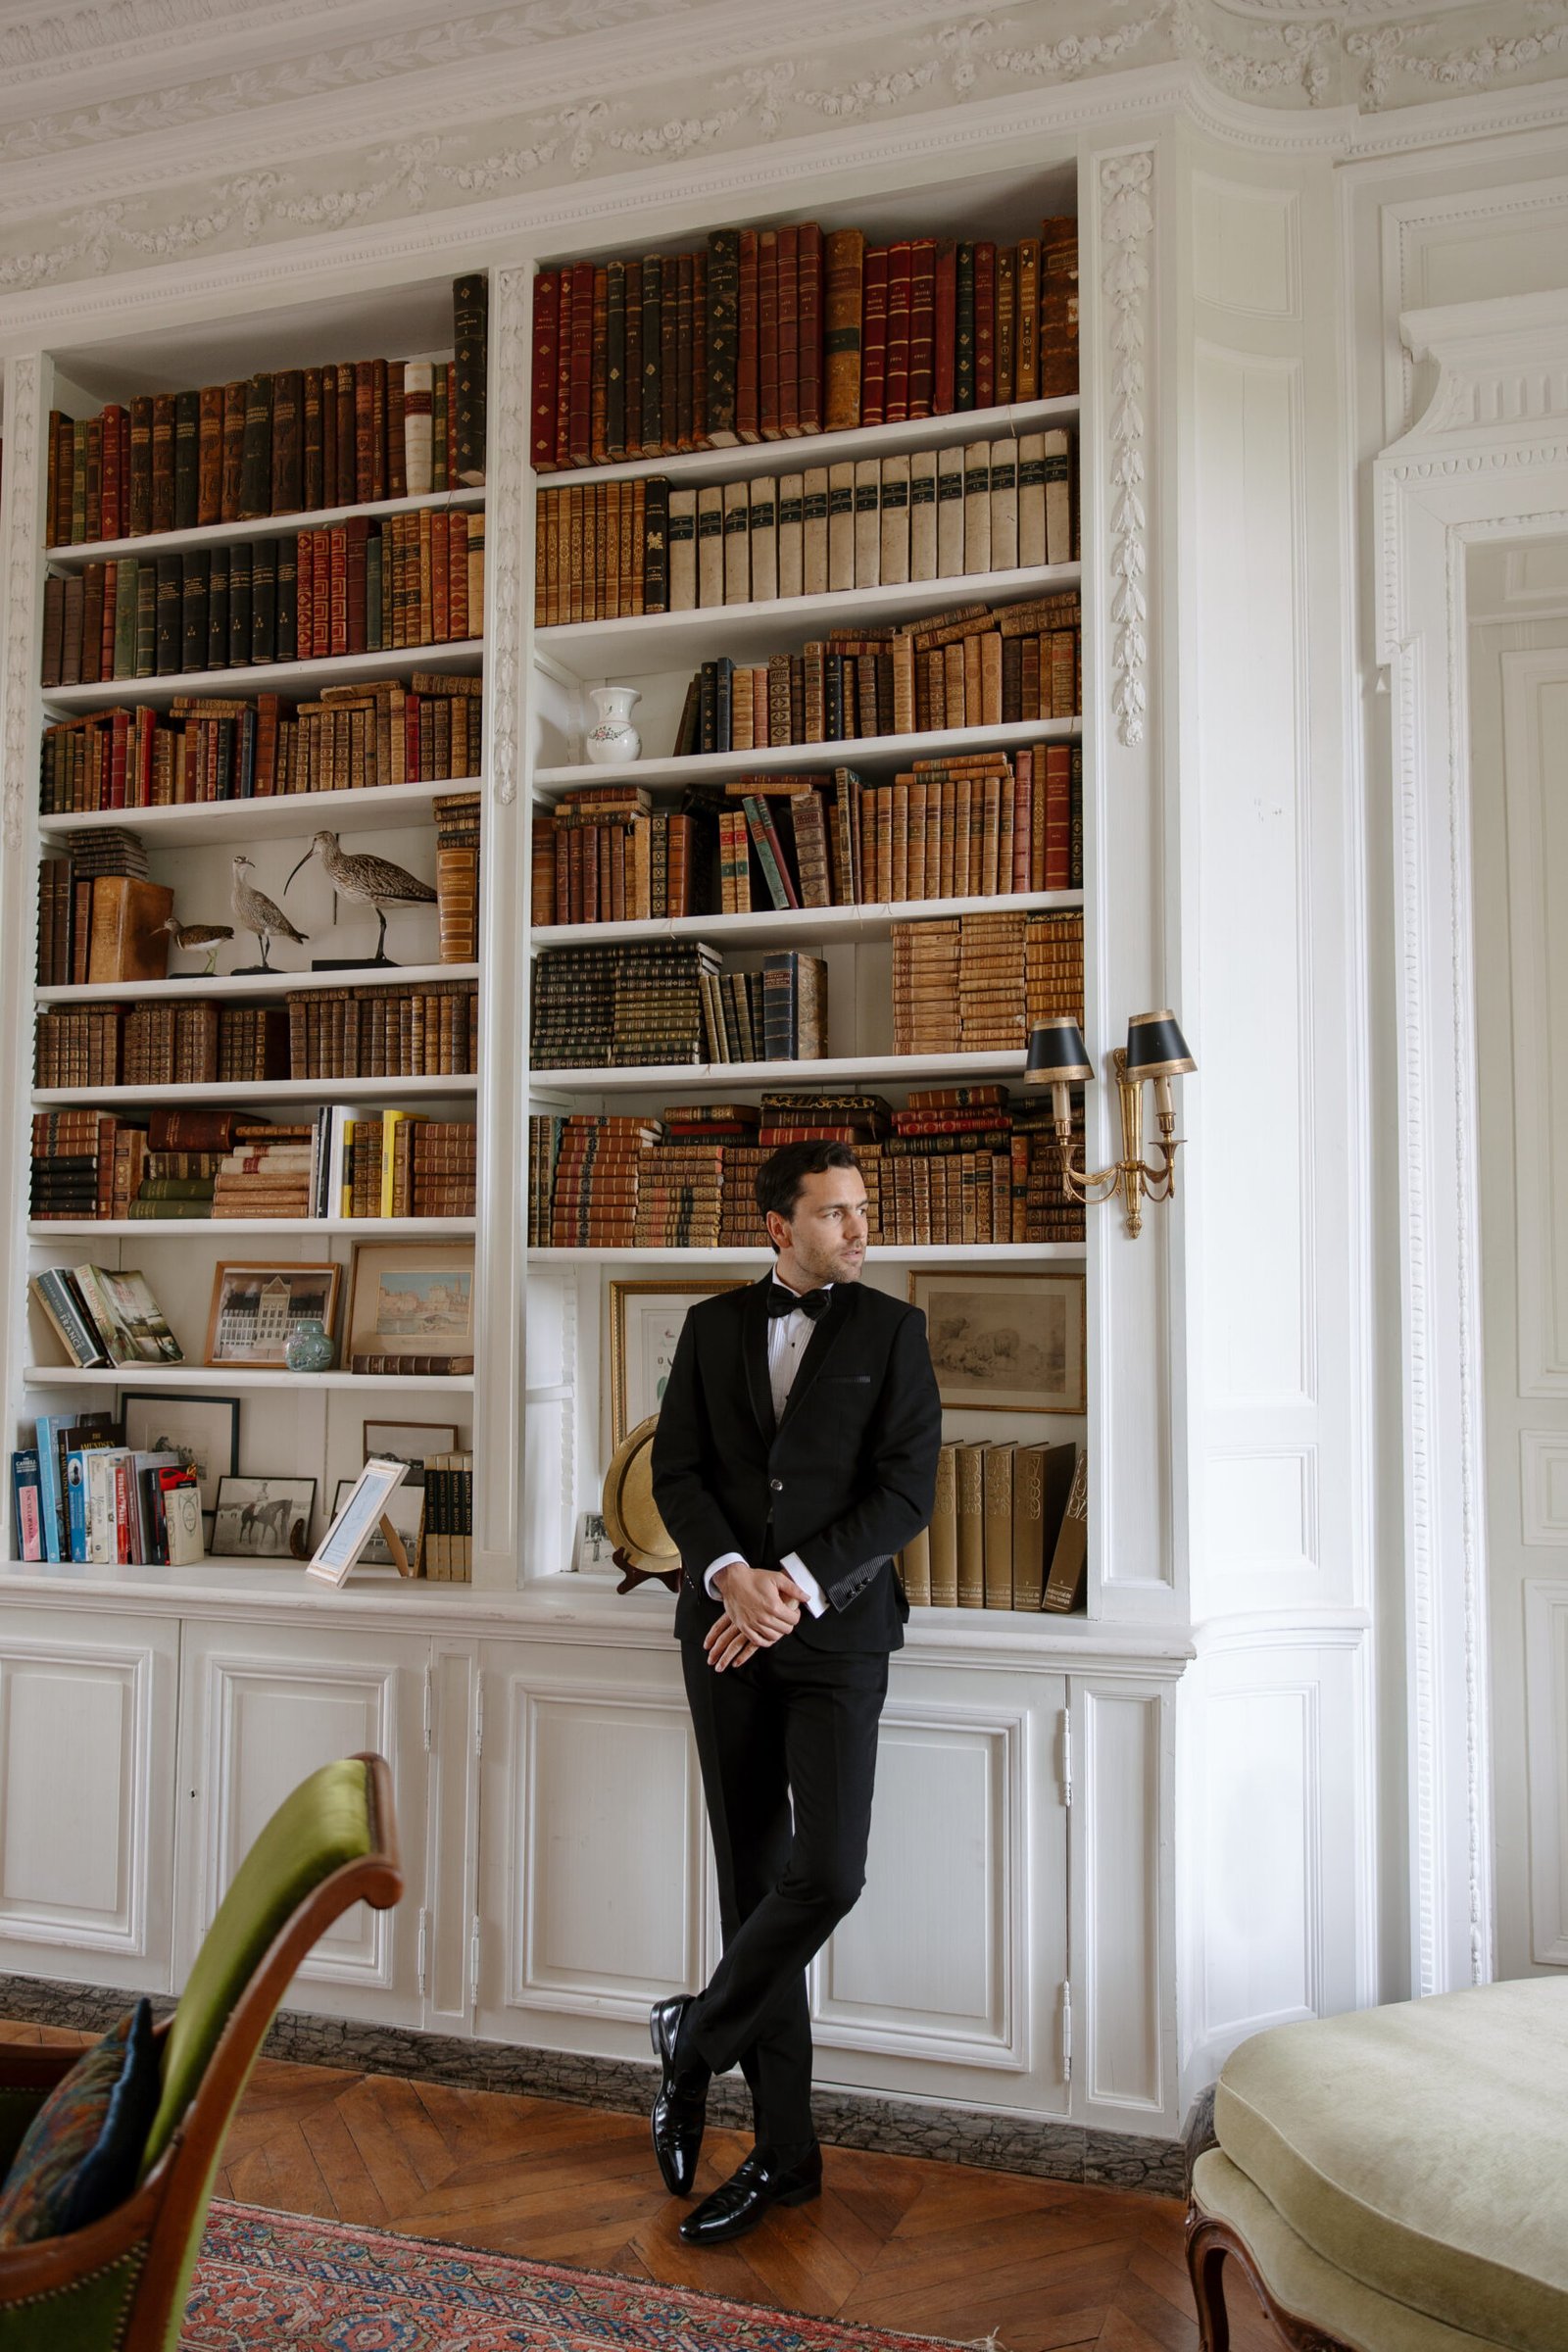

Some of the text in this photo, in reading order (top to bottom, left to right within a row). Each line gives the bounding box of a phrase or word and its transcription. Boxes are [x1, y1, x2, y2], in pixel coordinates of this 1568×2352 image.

[59, 1313, 82, 1349] FRANCE
[80, 1441, 116, 1450] AMUNDSEN
[60, 1456, 69, 1496] AMUNDSEN
